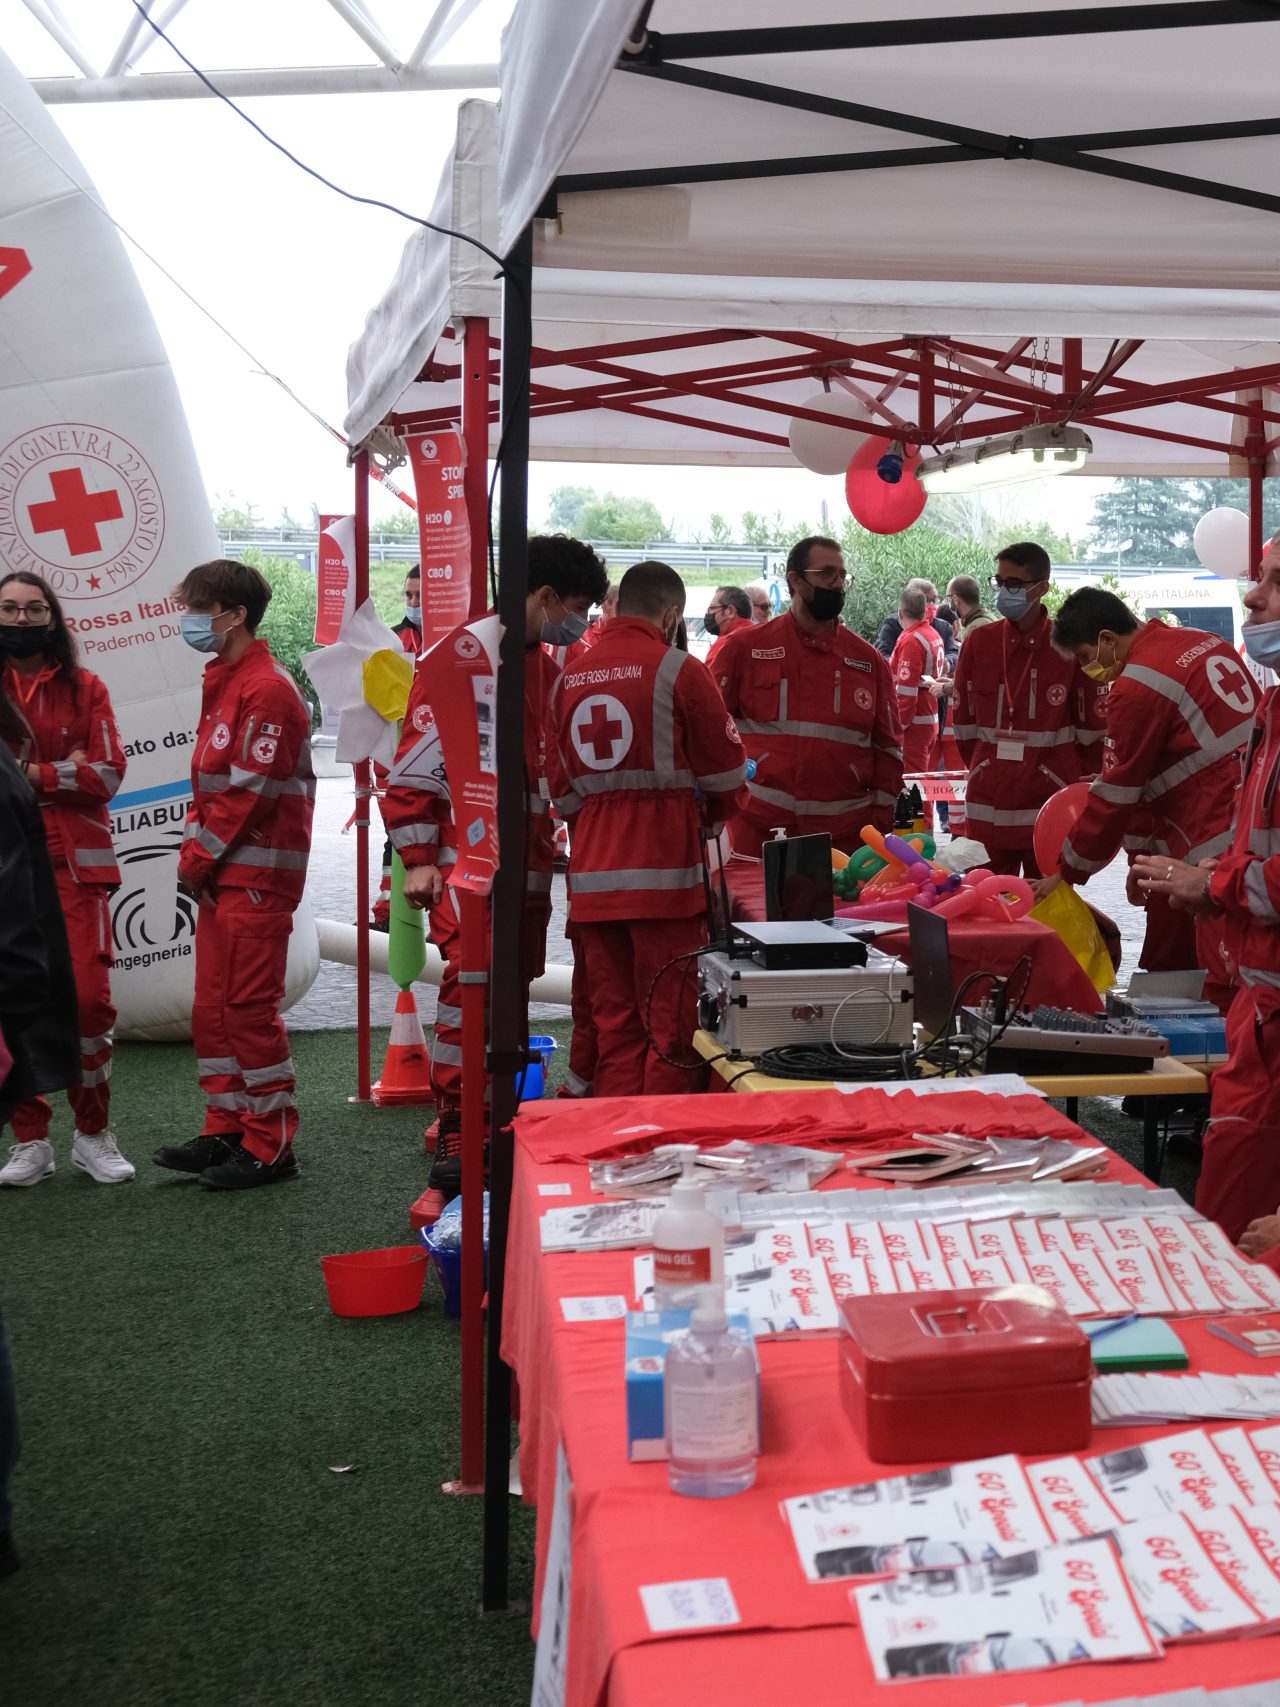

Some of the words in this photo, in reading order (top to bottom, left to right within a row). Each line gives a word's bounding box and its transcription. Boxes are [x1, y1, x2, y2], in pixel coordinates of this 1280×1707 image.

[20, 430, 112, 462] GINEVRA
[116, 453, 140, 478] 22
[130, 477, 158, 551] AGOSTO
[105, 551, 144, 585] 1864
[1161, 588, 1211, 600] ITALIANA
[84, 629, 156, 655] Paderno
[564, 672, 586, 690] CROCE
[586, 668, 610, 684] ROSSA
[610, 665, 643, 682] ITALIANA
[168, 729, 195, 749] da:
[673, 1253, 695, 1265] GEL
